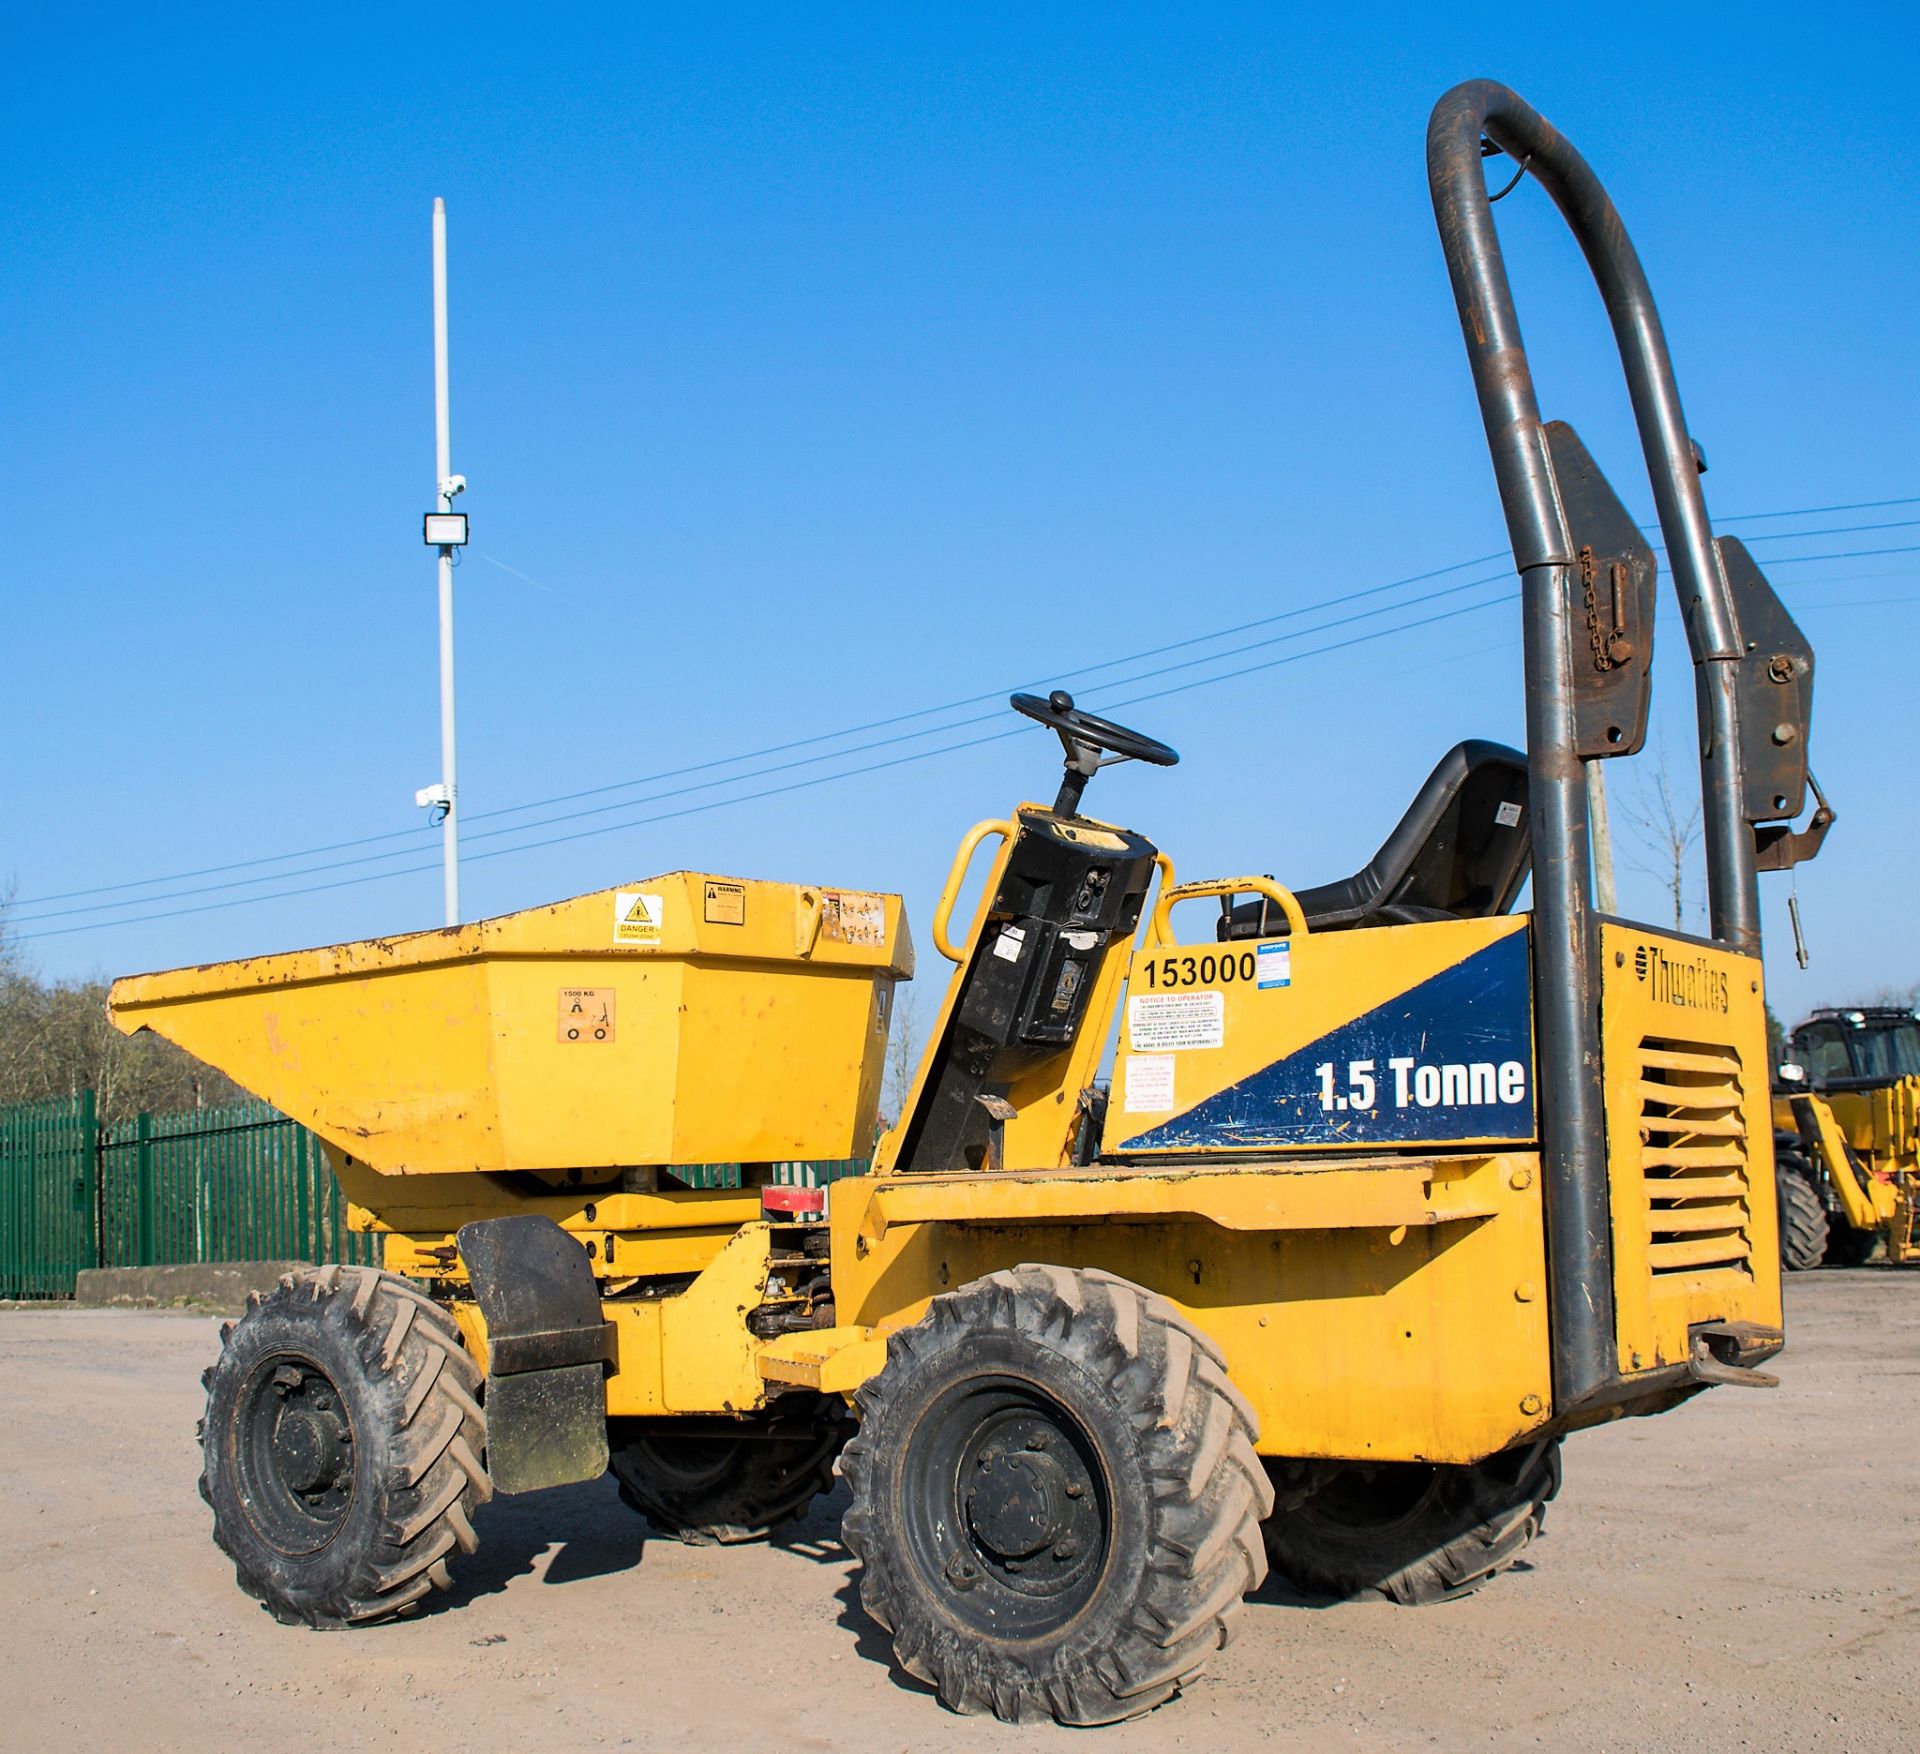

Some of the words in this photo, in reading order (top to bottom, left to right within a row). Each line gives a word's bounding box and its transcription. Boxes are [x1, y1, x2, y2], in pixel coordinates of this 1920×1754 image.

[620, 925, 654, 933] DANGER
[1144, 952, 1256, 988] 153000
[1649, 946, 1729, 1014] Thwaites
[1139, 996, 1164, 1004] NOTICE
[1178, 994, 1213, 1002] OPERATOR
[1315, 1058, 1377, 1111] 1.5
[1389, 1057, 1525, 1108] Tonne
